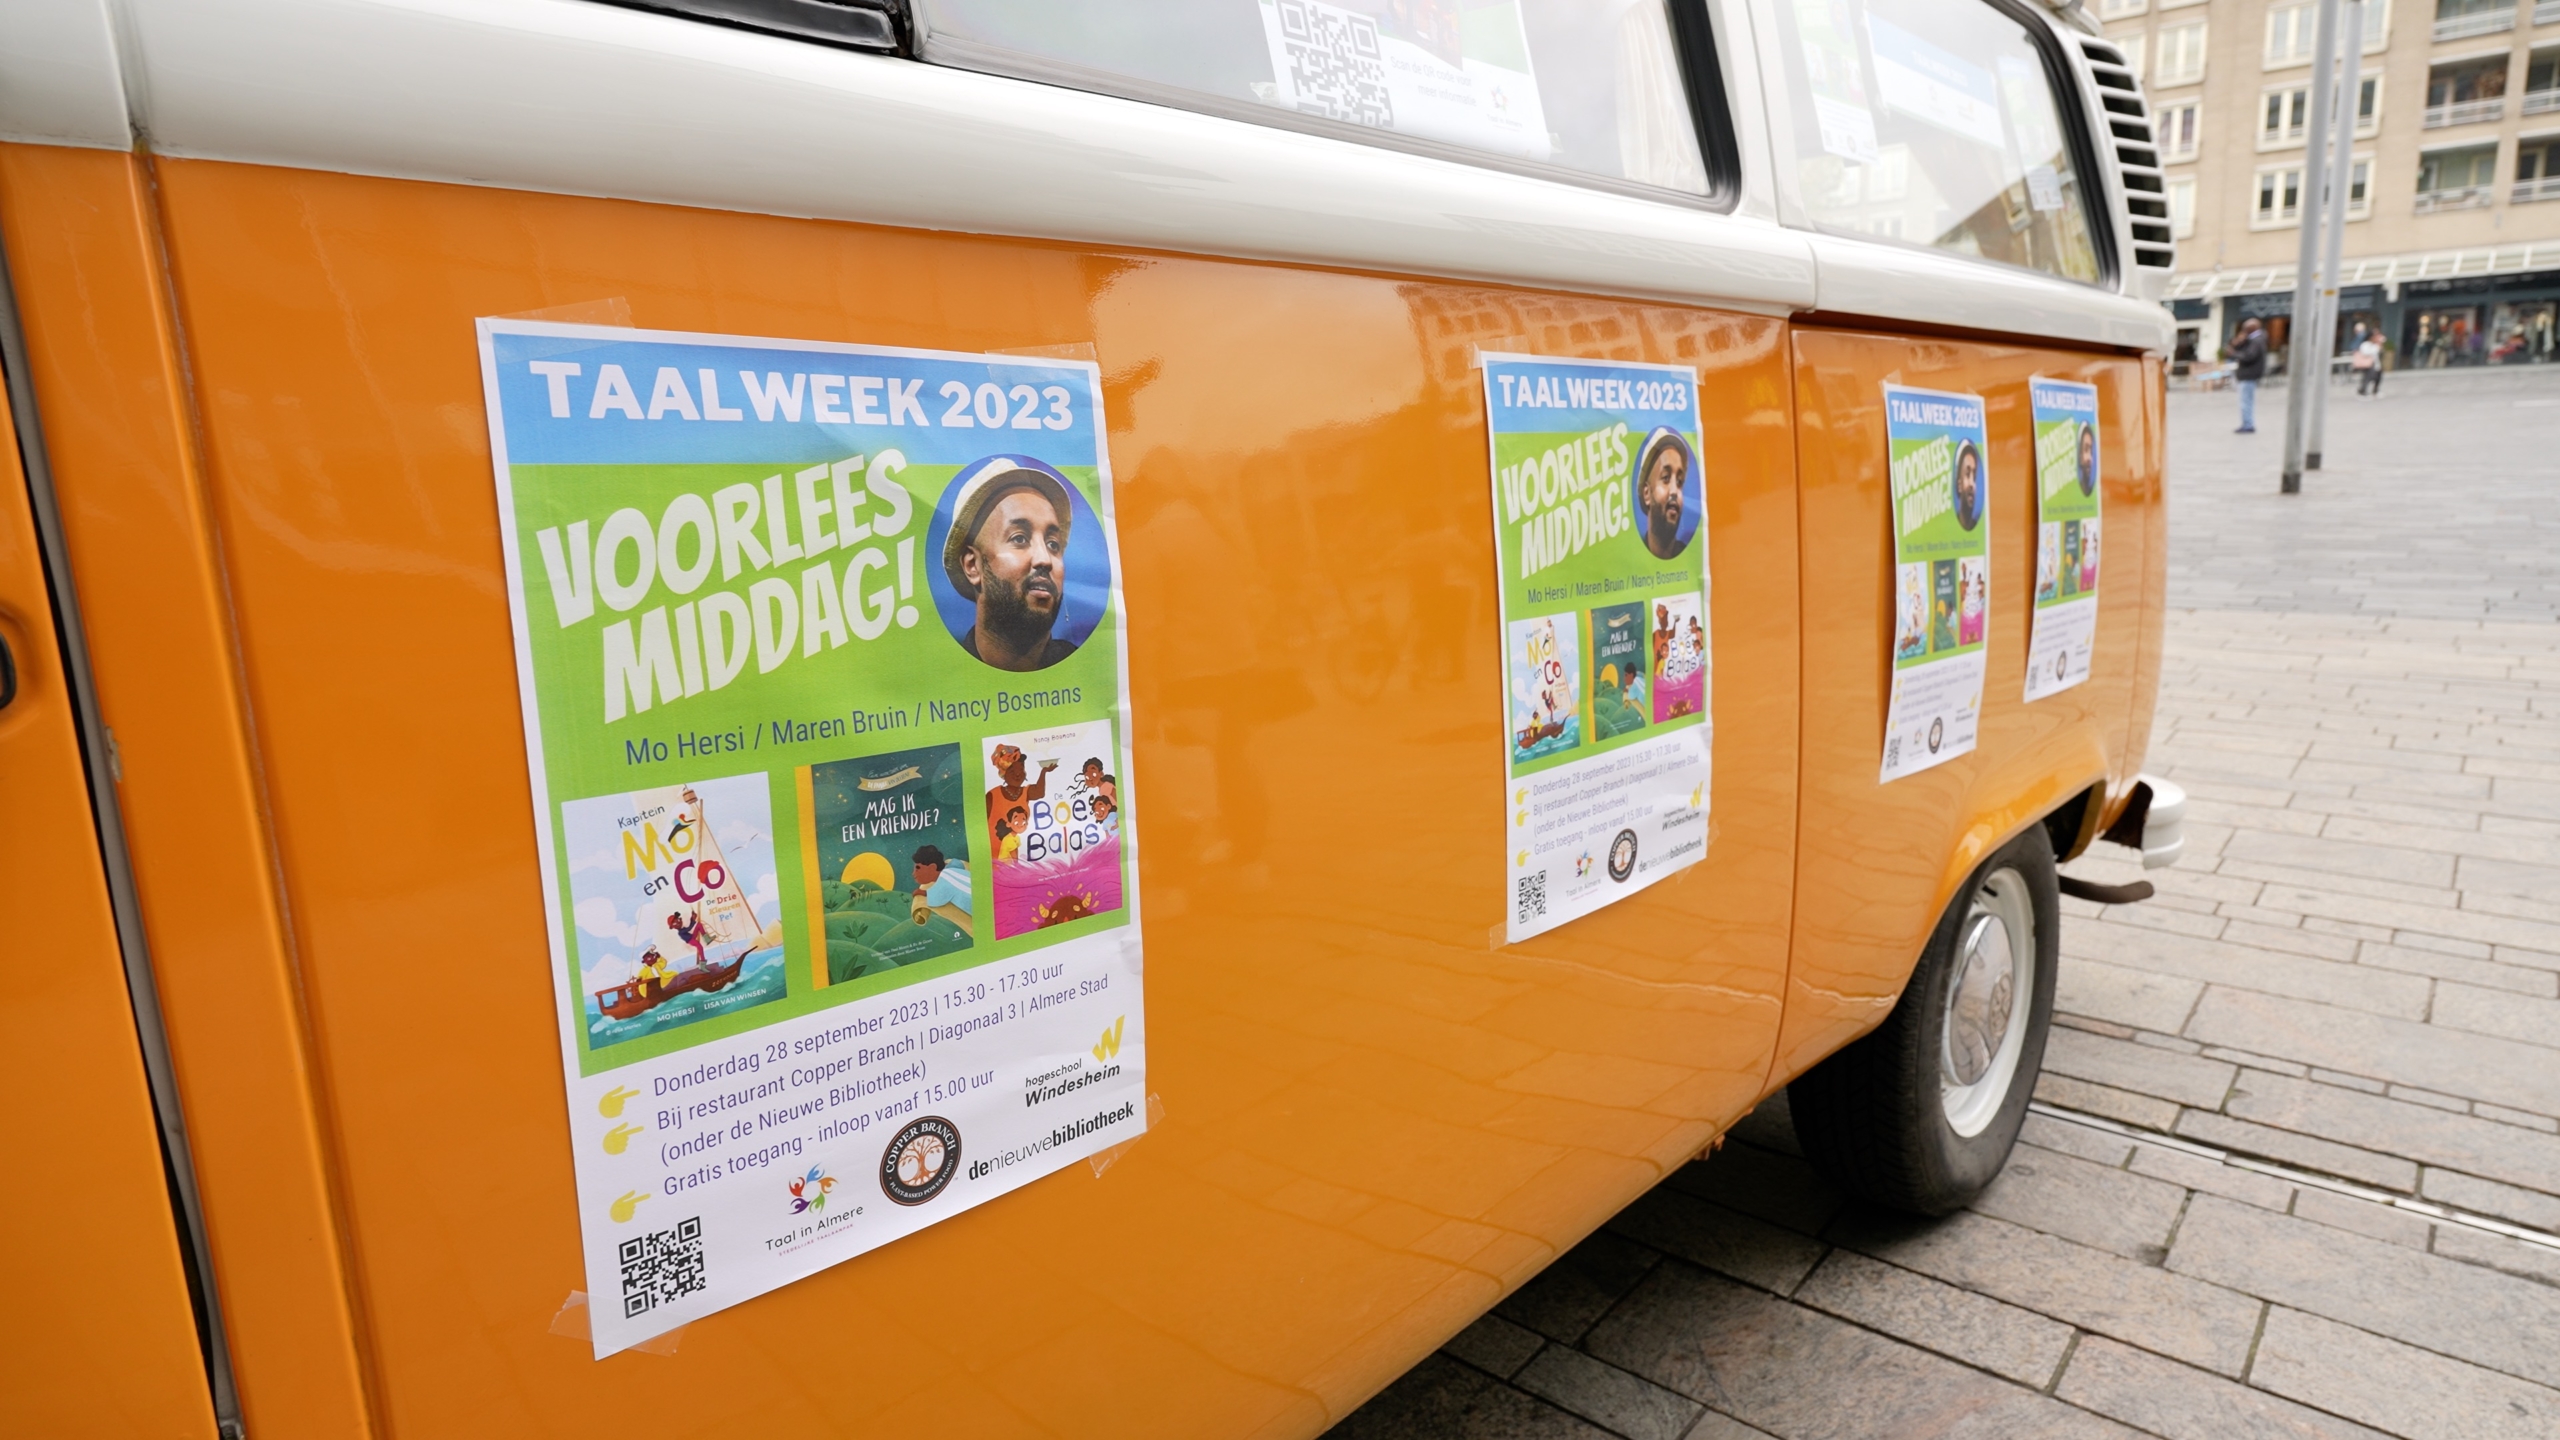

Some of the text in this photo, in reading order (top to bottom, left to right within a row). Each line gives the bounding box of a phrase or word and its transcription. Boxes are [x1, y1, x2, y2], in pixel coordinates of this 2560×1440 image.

[1412, 62, 1422, 74] de
[1423, 64, 1435, 79] QR
[529, 361, 1073, 430] TAALWEEK 2023
[1497, 374, 1688, 411] TAALWEEK 2023
[1891, 399, 1979, 428] TAALWEEK 2023
[1501, 422, 1629, 525] VOORLEES
[1893, 434, 1951, 500] VOORLEES
[1903, 471, 1952, 537] MIDDAG!
[536, 448, 913, 629] VOORLEES
[1521, 475, 1630, 580] MIDDAG!
[1528, 589, 1542, 604] Mo
[1544, 585, 1567, 601] Hersi
[1576, 582, 1602, 596] Maren
[1604, 577, 1624, 592] Bruin
[1631, 574, 1655, 589] Nancy
[1656, 570, 1688, 585] Bosmans
[603, 536, 920, 724] MIDDAG!
[1544, 660, 1562, 685] Co
[626, 686, 1082, 765] Mo Hersi / Maren Bruin / Nancy Bosmans
[1054, 792, 1063, 800] De
[1533, 776, 1571, 796] Donderdag
[1572, 772, 1580, 784] 28
[1582, 762, 1615, 783] september
[1616, 756, 1631, 771] 2023
[1533, 803, 1543, 817] Bij
[1544, 793, 1578, 812] restaurant
[1580, 784, 1603, 801] Copper
[1603, 777, 1624, 793] Branch
[1629, 766, 1658, 785] Diagonaal
[1667, 759, 1686, 771] Almere
[617, 805, 665, 829] Kapitein
[842, 808, 940, 843] EEN VRIENDJE?
[865, 793, 915, 819] MAG IK
[1033, 799, 1088, 830] Boe
[1534, 793, 1629, 838] (onder de Nieuwe Bibliotheek)
[621, 822, 695, 881] Mo
[1027, 823, 1099, 862] Balas
[1534, 840, 1555, 855] Gratis
[1556, 830, 1583, 848] toegang
[1588, 821, 1608, 836] inloop
[1609, 812, 1626, 828] vanaf
[643, 875, 669, 896] en
[674, 858, 725, 904] Co
[706, 892, 737, 906] De Drie
[708, 901, 741, 916] Kleuren
[719, 912, 733, 922] Pet
[657, 988, 767, 1023] MO HERSI LISA VAN WINSEN
[654, 1052, 760, 1096] Donderdag
[765, 1041, 788, 1063] 28
[794, 1015, 884, 1055] september
[889, 999, 929, 1027] 2023
[943, 983, 986, 1010] 15.30
[999, 968, 1038, 993] 17.30
[1042, 962, 1064, 980] uur
[657, 1106, 682, 1130] Bij
[689, 1076, 785, 1120] restaurant
[791, 1057, 853, 1087] Copper
[858, 1035, 915, 1067] Branch
[929, 1006, 1003, 1044] Diagonaal
[1008, 1003, 1016, 1019] 3
[1029, 987, 1076, 1013] Almere
[1080, 973, 1108, 996] Stad
[1025, 1058, 1082, 1088] hogeschool
[1025, 1064, 1120, 1108] Windesheim
[660, 1059, 927, 1167] (onder de Nieuwe Bibliotheek)
[664, 1163, 722, 1196] Gratis
[727, 1136, 803, 1174] toegang
[818, 1113, 870, 1143] inloop
[875, 1090, 920, 1122] vanaf
[923, 1076, 966, 1105] 15.00
[971, 1068, 995, 1089] uur
[885, 1122, 956, 1173] COPPER BRANCH
[968, 1101, 1134, 1181] denieuwebibliotheek
[890, 1180, 923, 1199] PLANT-BASED
[923, 1177, 944, 1196] POWER
[765, 1206, 864, 1251] Taal in Almere
